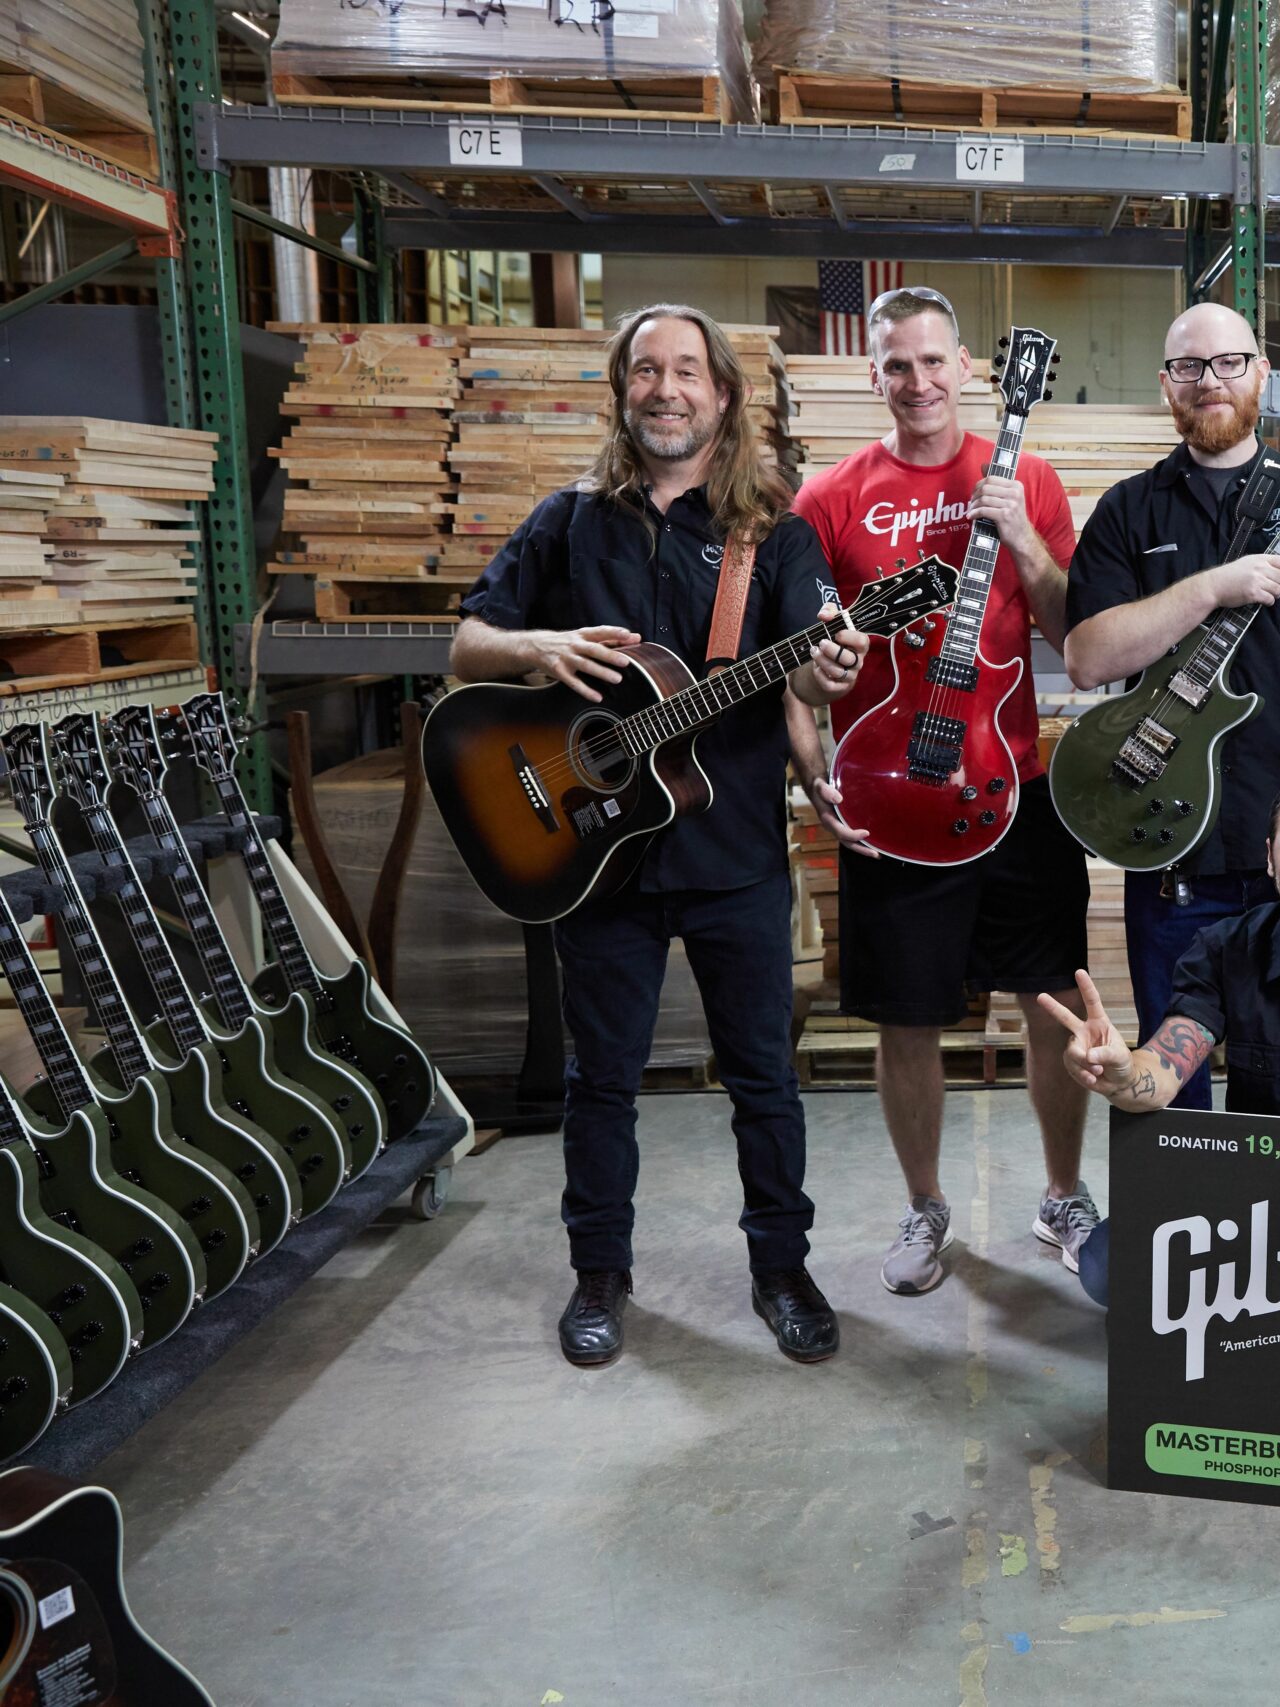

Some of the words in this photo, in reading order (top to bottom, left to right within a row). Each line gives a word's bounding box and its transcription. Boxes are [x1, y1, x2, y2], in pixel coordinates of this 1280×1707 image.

[459, 129, 483, 155] C7
[489, 130, 502, 155] E
[965, 146, 988, 170] C7
[993, 148, 1004, 171] F
[1022, 333, 1045, 345] Gibson
[860, 491, 974, 547] Epipho
[926, 528, 946, 536] Since
[949, 523, 970, 533] 1873
[927, 564, 950, 601] Epiphone
[1158, 1134, 1238, 1152] DONATING
